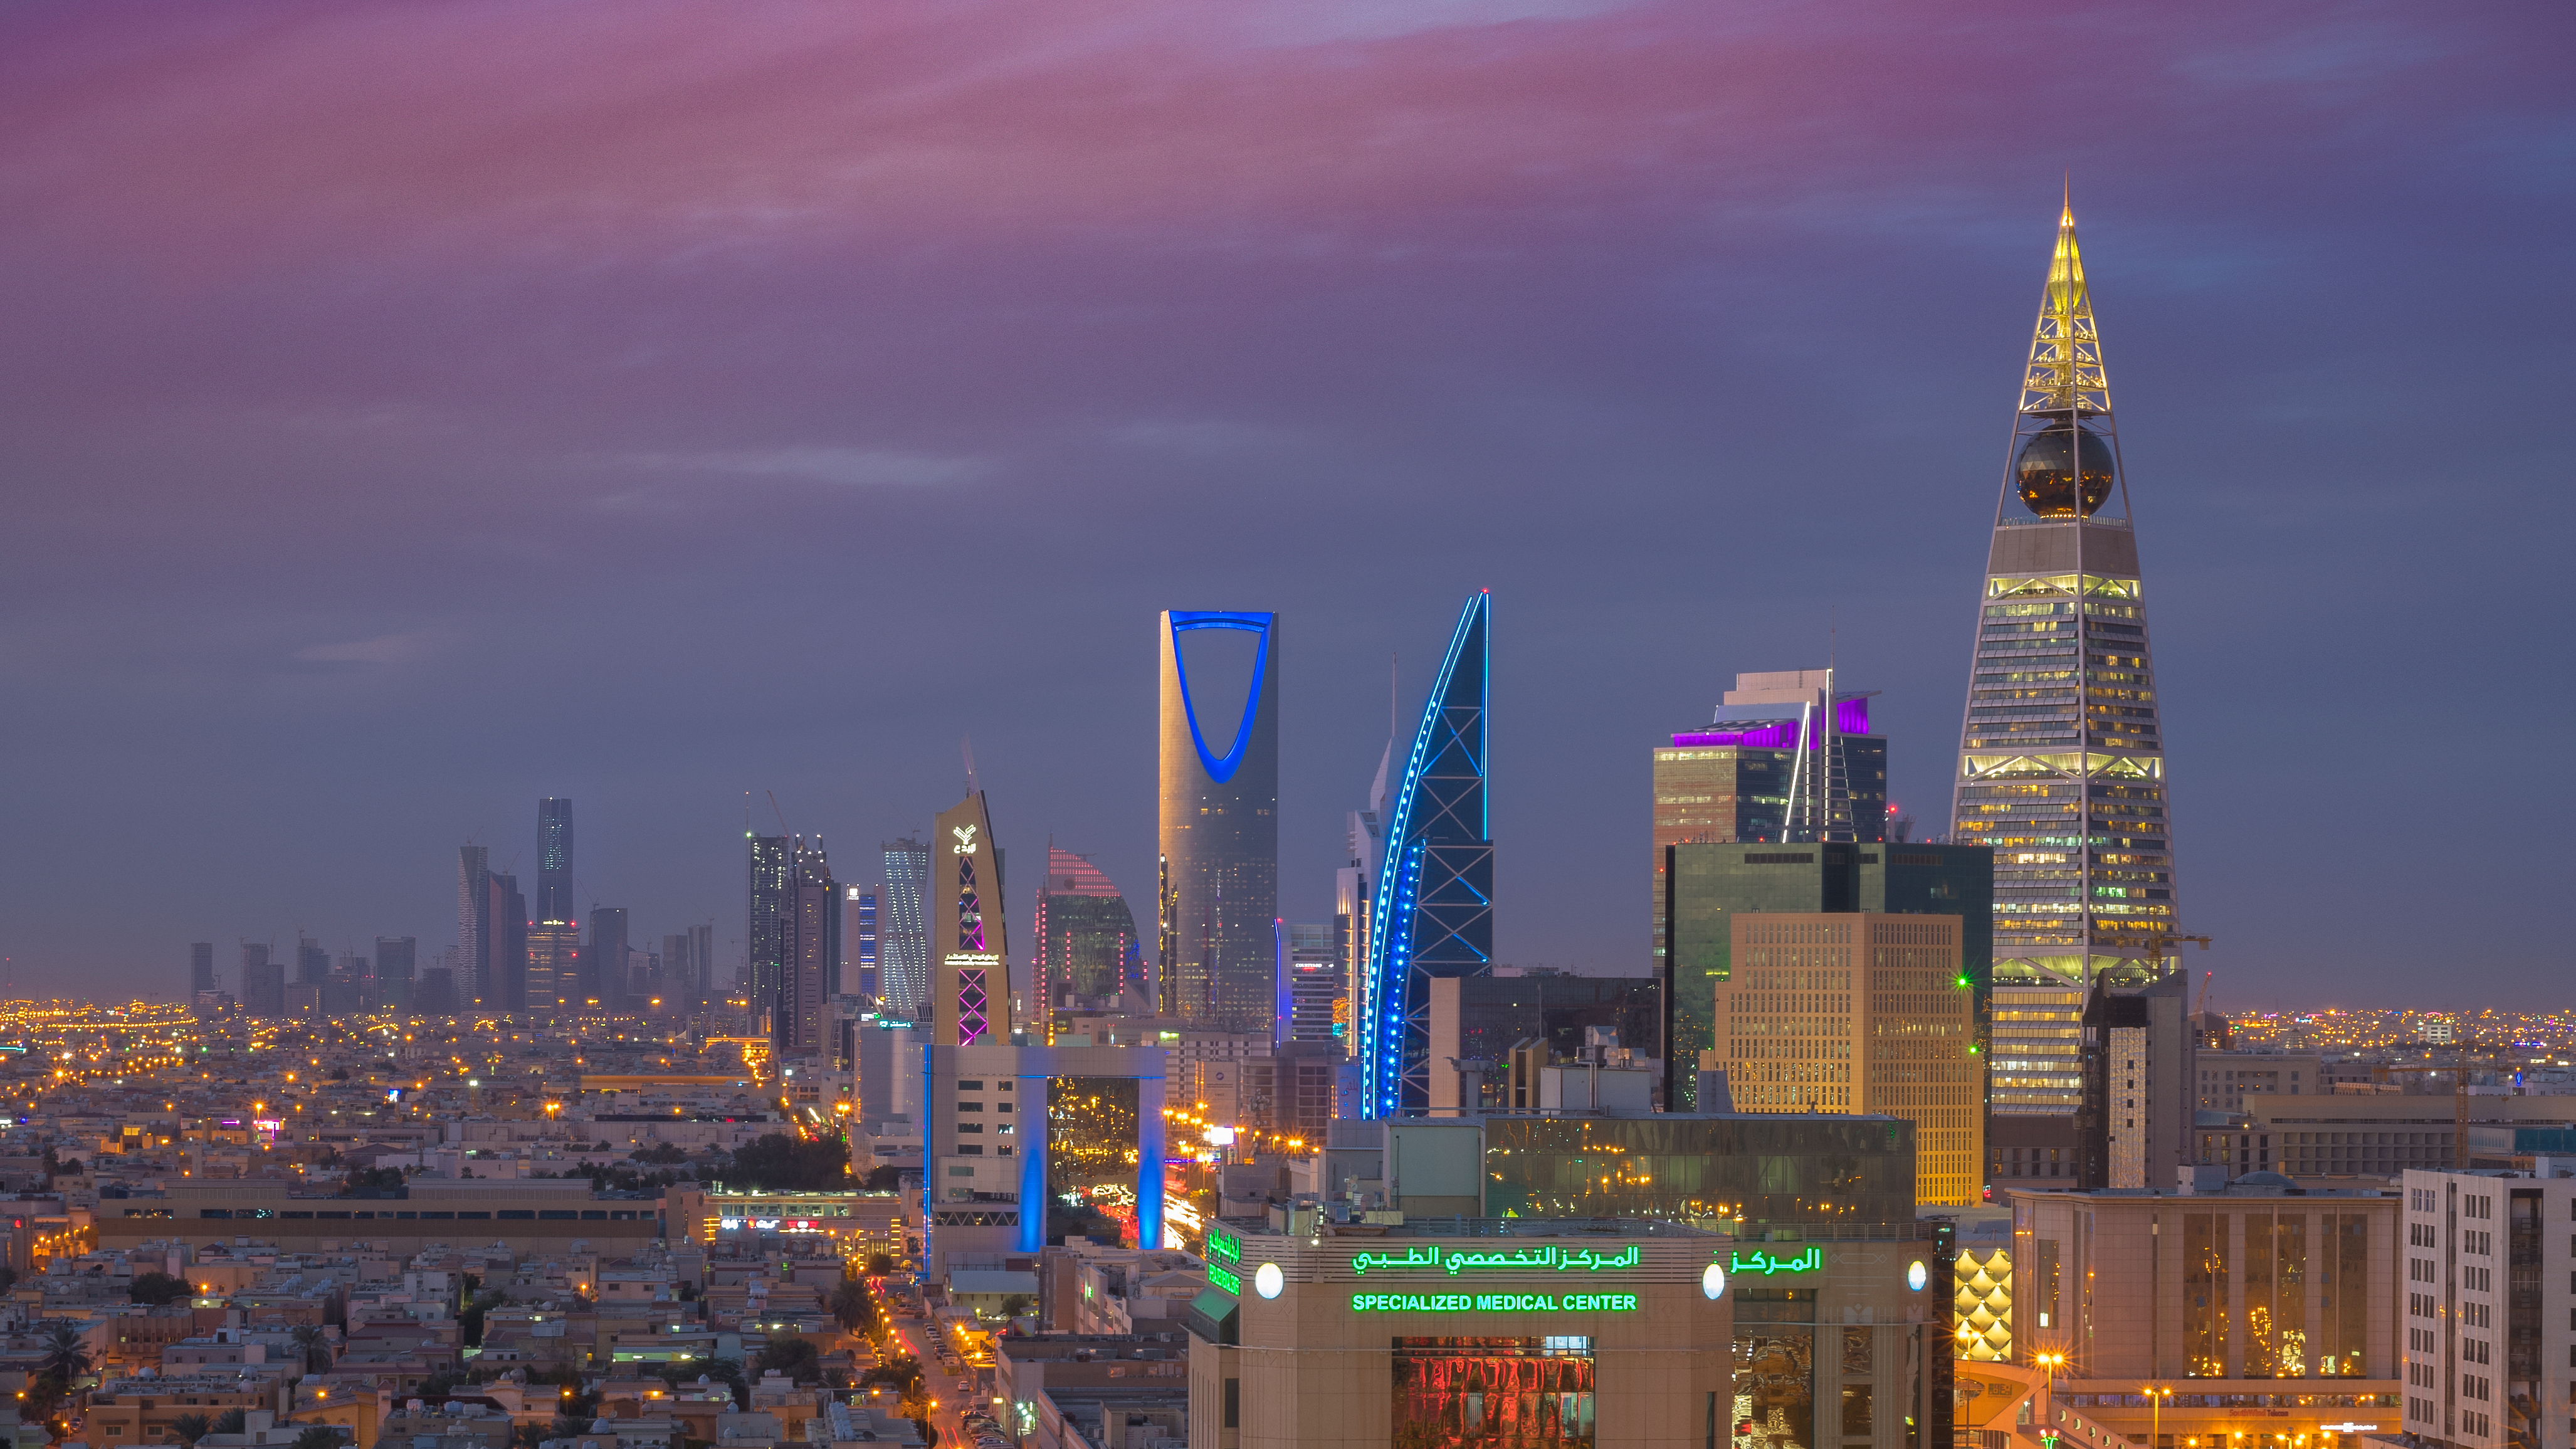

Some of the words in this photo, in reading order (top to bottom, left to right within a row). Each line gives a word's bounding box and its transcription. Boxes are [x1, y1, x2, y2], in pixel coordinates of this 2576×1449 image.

[1352, 1246, 1439, 1275] الطبي
[1445, 1246, 1557, 1275] التخصصي
[1557, 1246, 1639, 1270] المركز
[1730, 1248, 1821, 1275] المركز
[1353, 1295, 1472, 1310] SPECIALIZED
[1476, 1295, 1559, 1310] MEDICAL
[1562, 1295, 1637, 1310] CENTER
